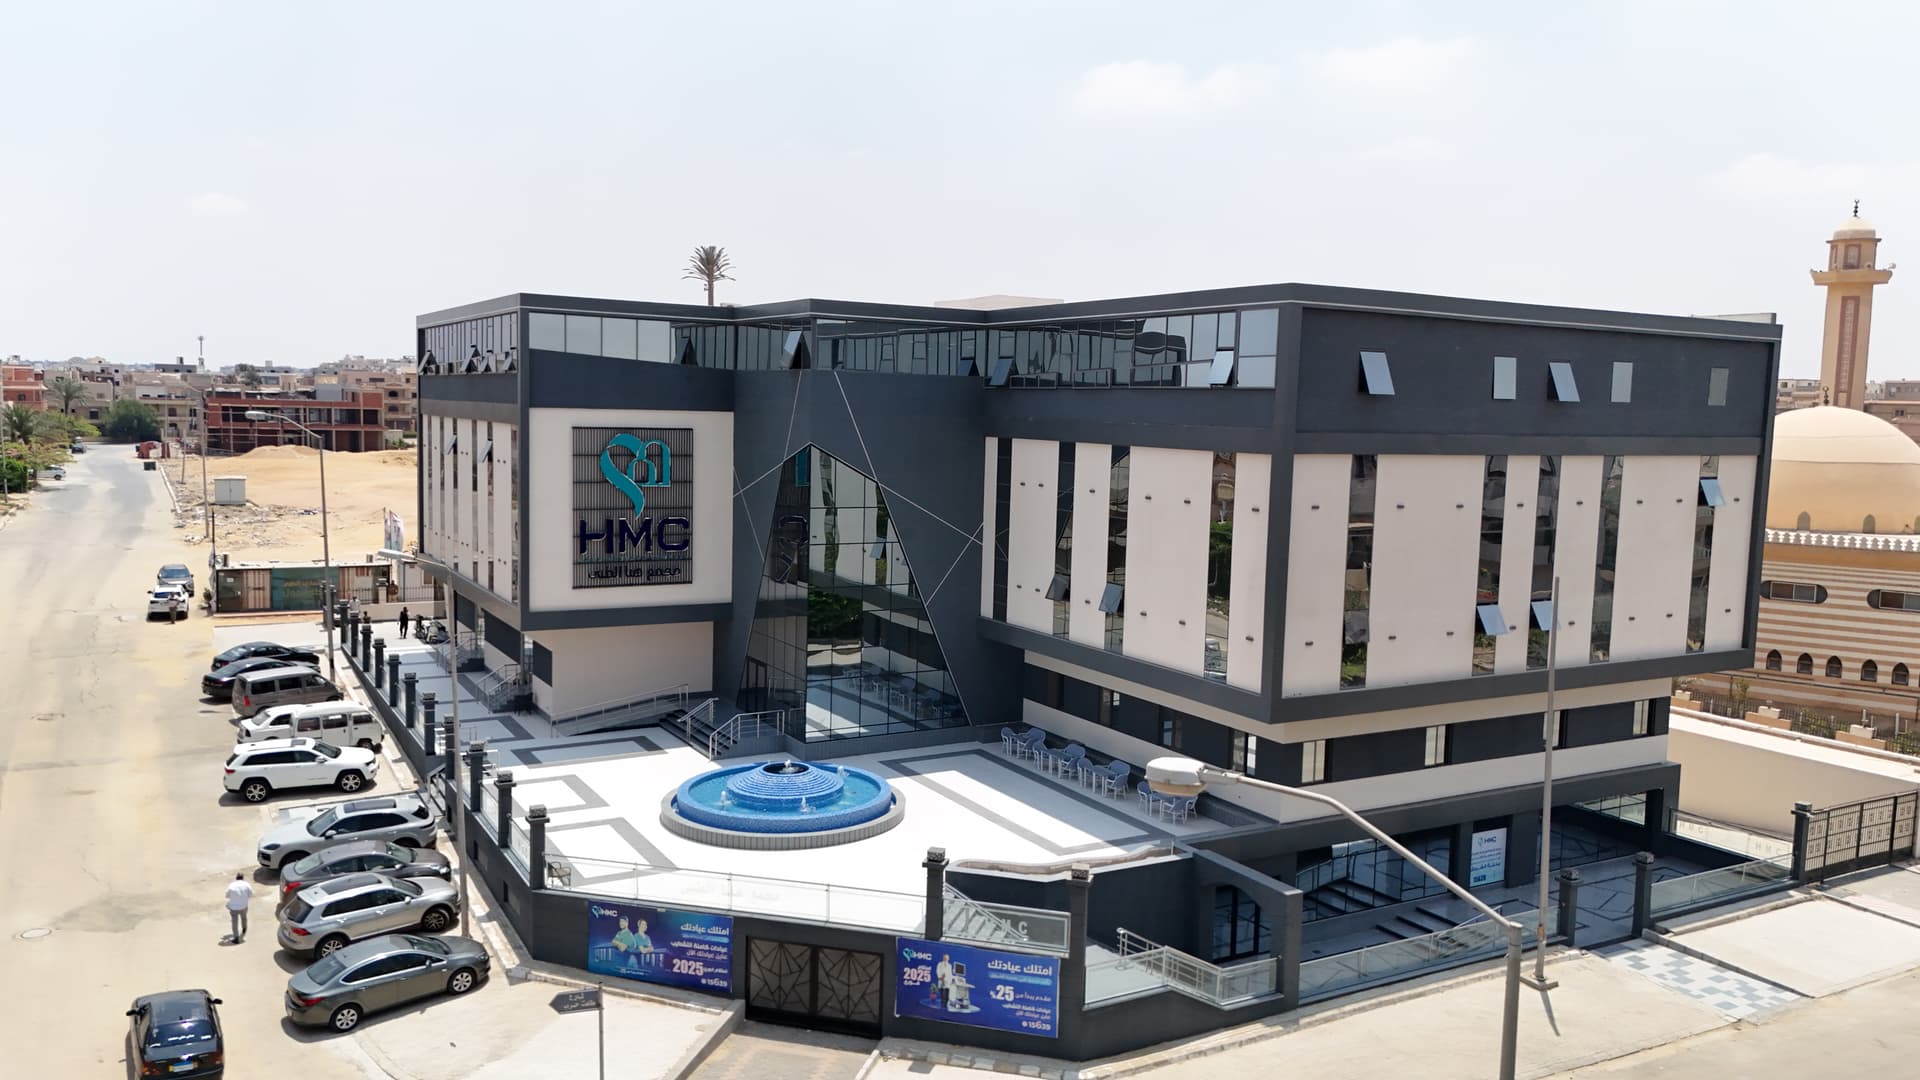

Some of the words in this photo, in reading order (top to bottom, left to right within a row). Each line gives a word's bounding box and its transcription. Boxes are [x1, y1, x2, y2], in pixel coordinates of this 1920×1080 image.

[579, 517, 690, 555] HMC
[601, 908, 618, 917] HMC
[680, 922, 706, 934] عيادتك
[707, 925, 730, 936] امتلك
[911, 951, 932, 961] HMC
[672, 958, 704, 976] 2025
[987, 959, 1021, 974] عيادتك
[1023, 964, 1053, 976] امتلك
[903, 967, 932, 983] 2025
[1028, 1020, 1051, 1031] 15639
